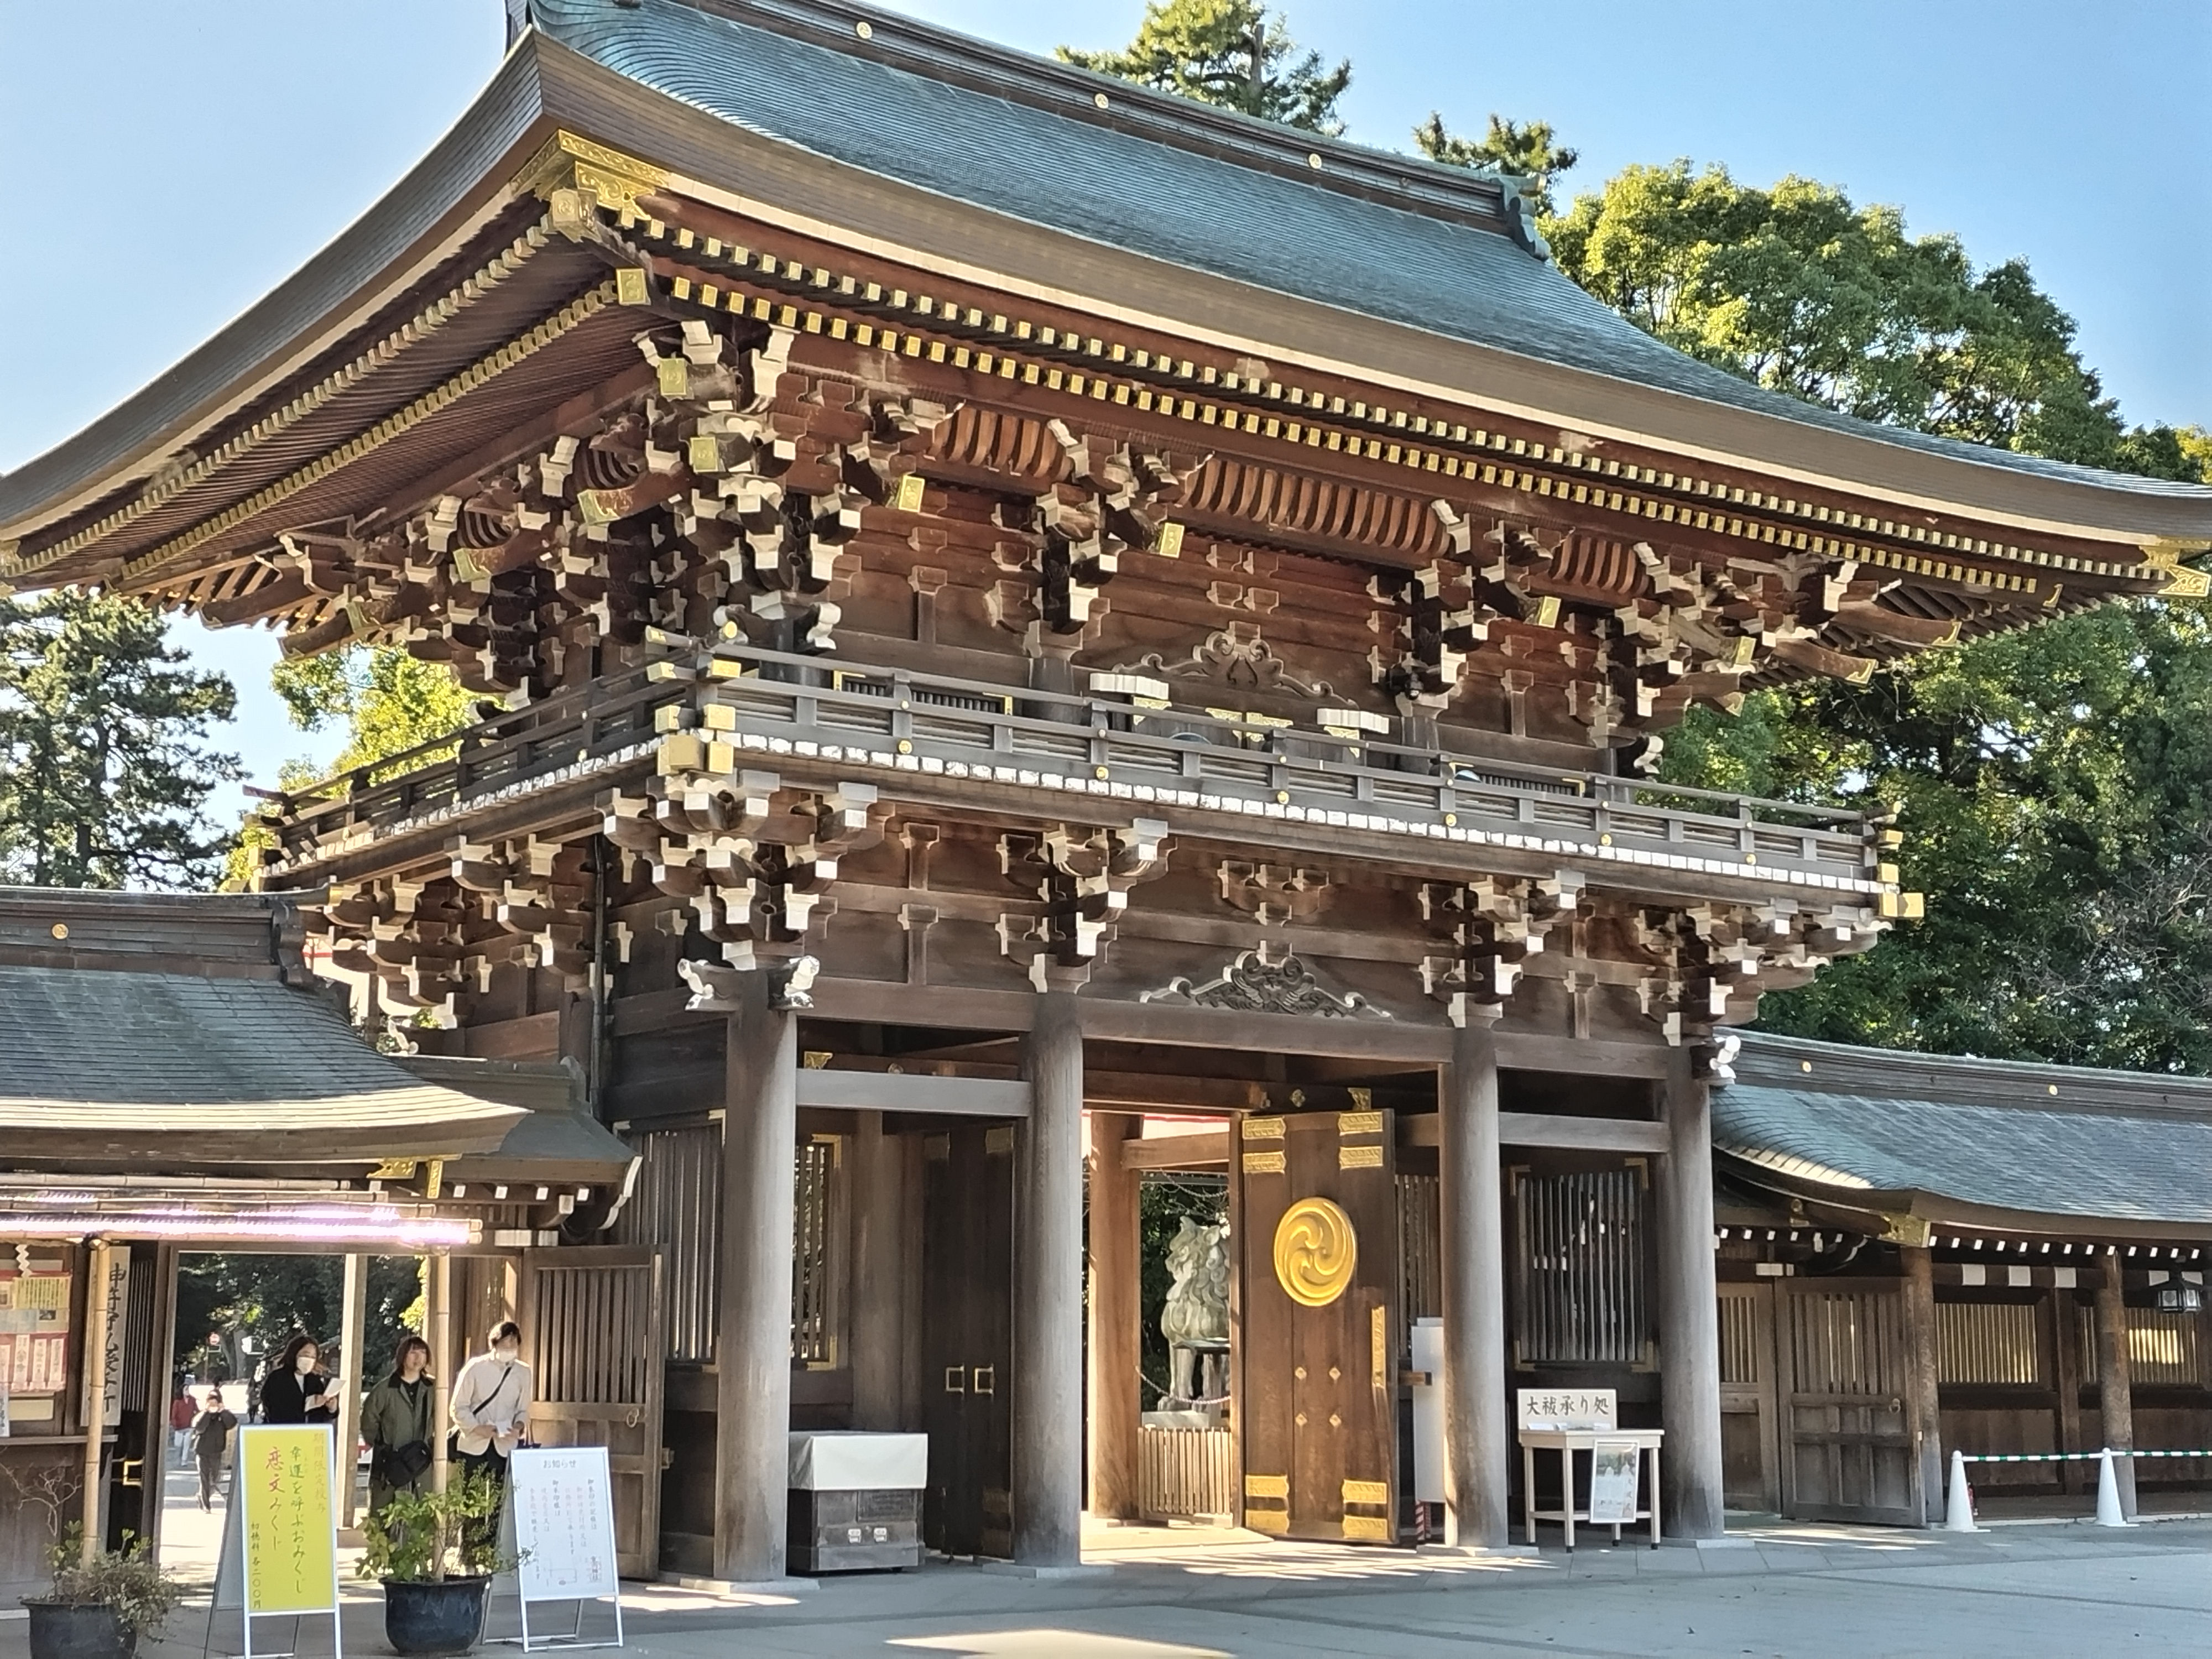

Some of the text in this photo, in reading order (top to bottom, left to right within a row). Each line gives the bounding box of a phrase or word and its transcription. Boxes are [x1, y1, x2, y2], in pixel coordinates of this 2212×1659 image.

[1526, 1395, 1609, 1416] 大祓承り処
[542, 1459, 577, 1469] お知らせ
[265, 1446, 285, 1551] 恋文みくじ
[289, 1446, 306, 1594] 幸運を呼ぶおみくじ
